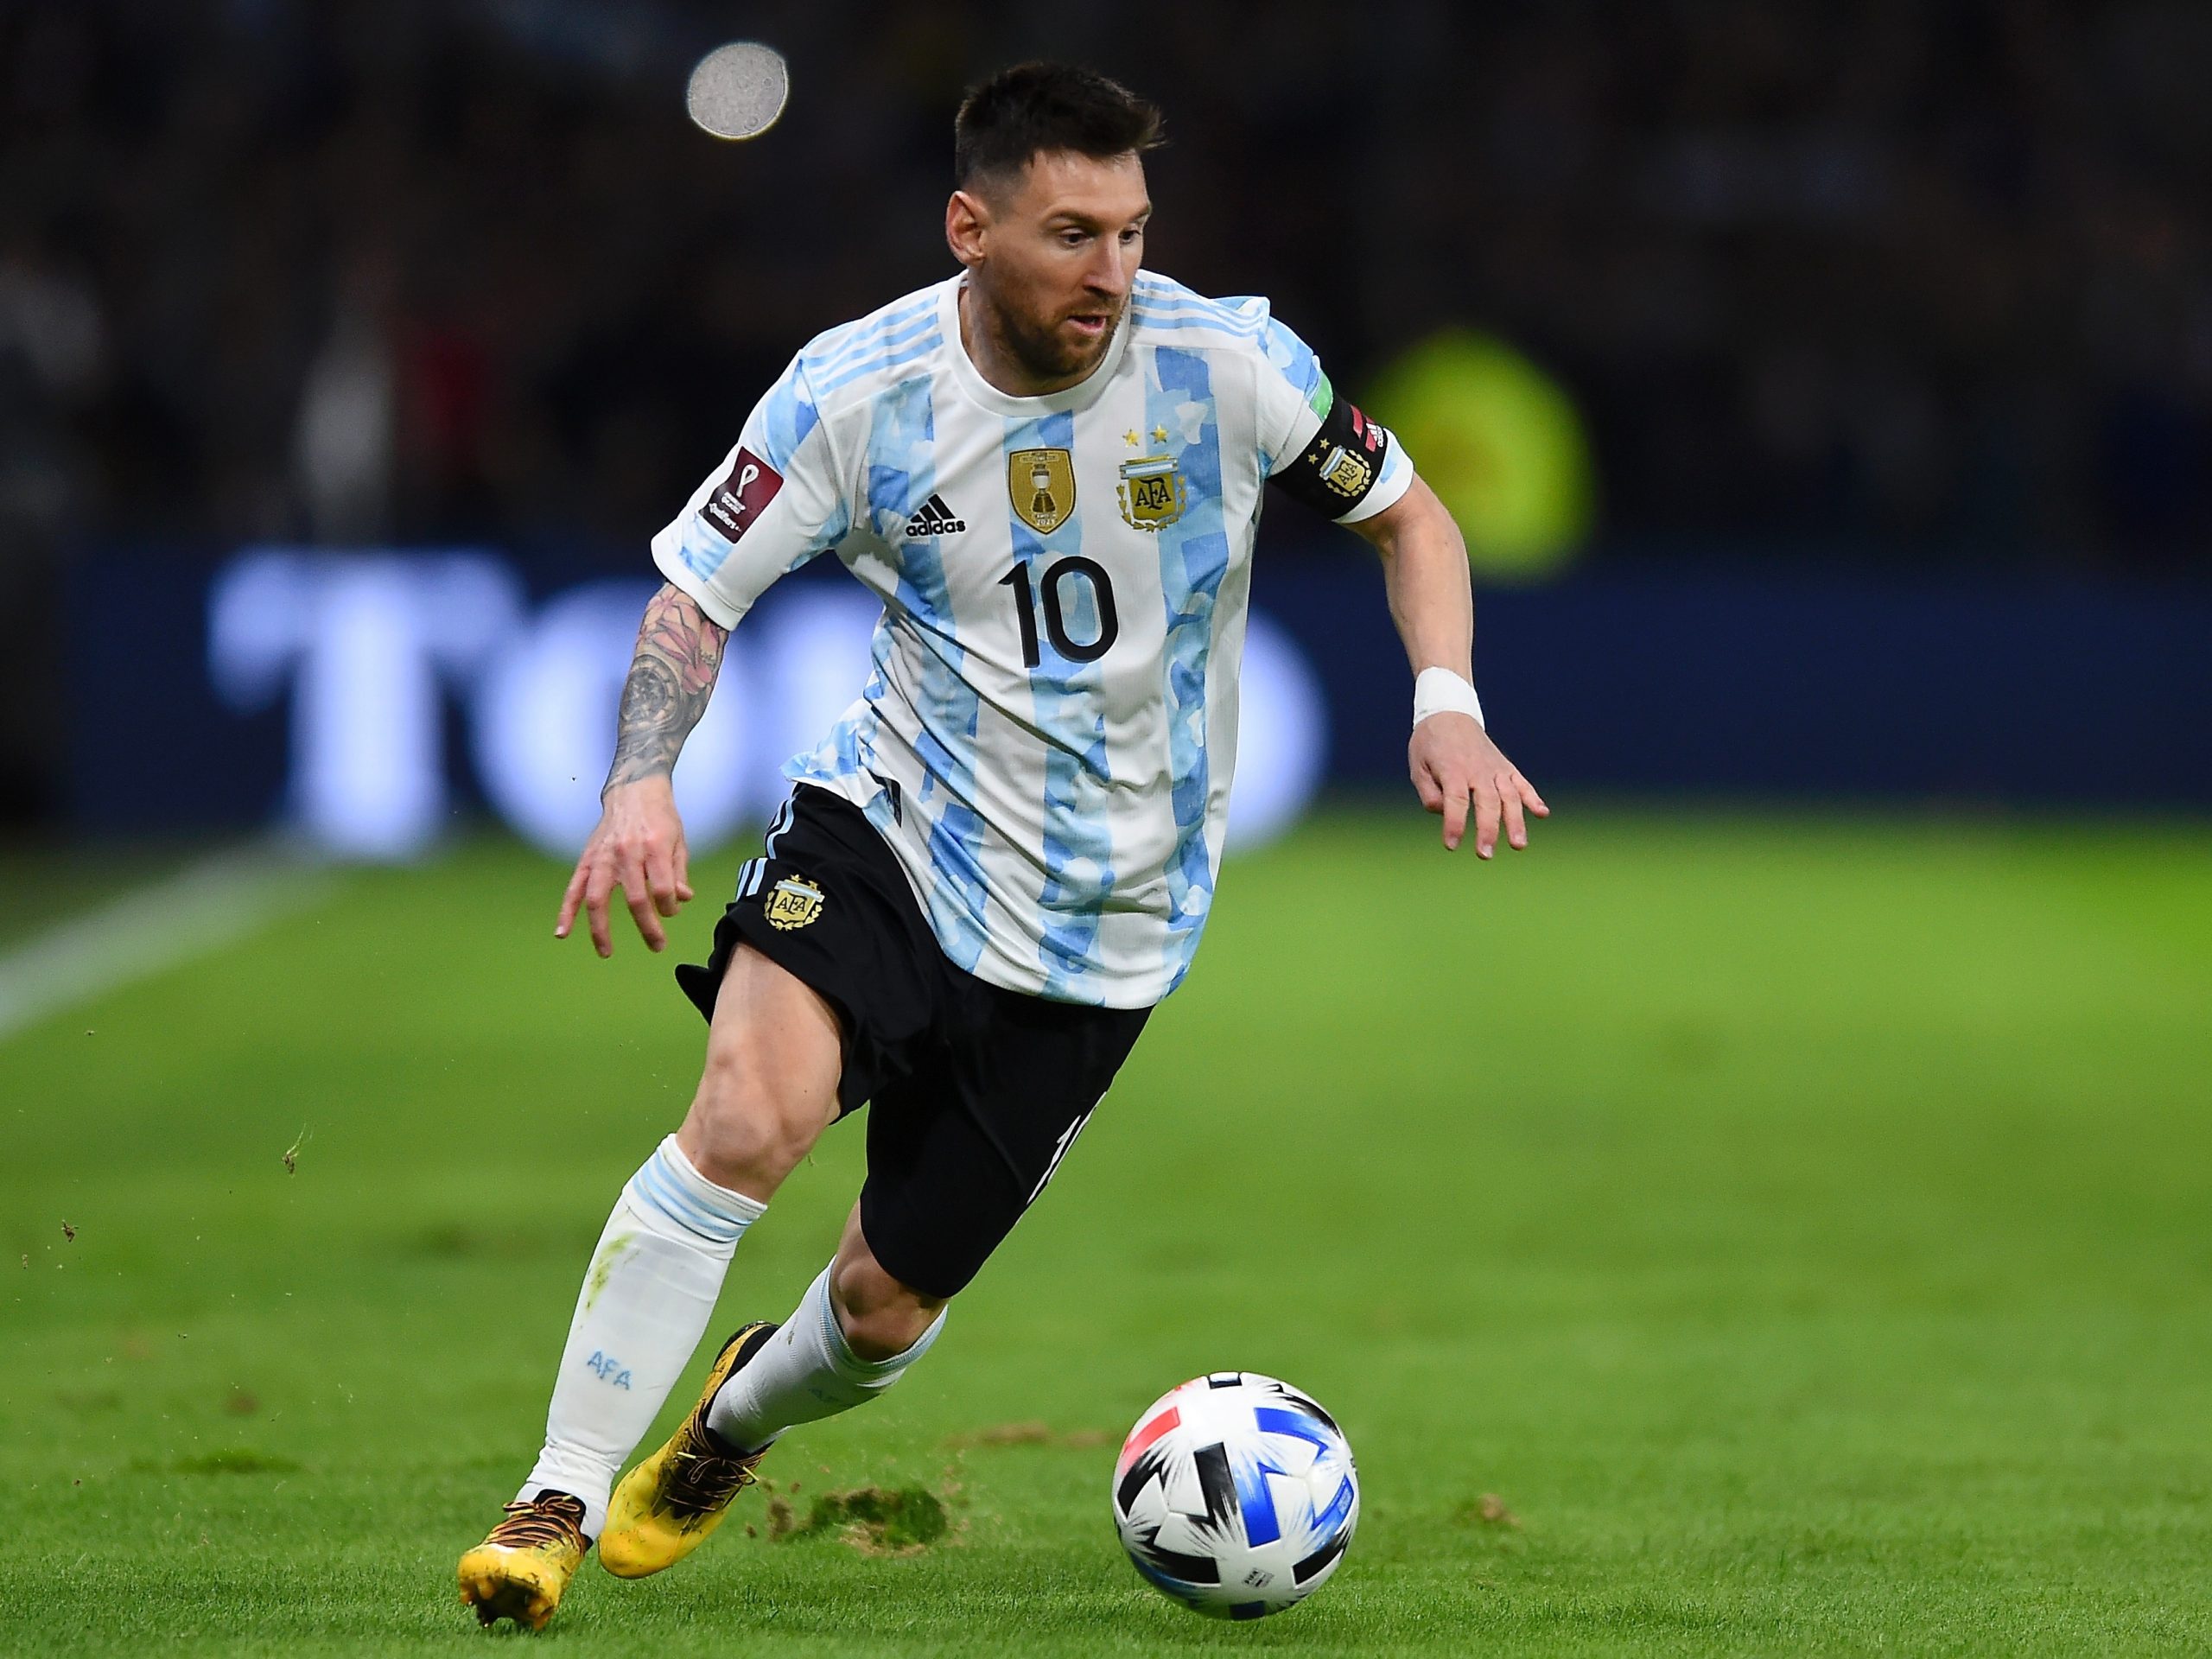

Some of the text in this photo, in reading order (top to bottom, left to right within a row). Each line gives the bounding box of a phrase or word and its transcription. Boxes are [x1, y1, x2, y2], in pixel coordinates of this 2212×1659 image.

[1135, 477, 1172, 510] AFA
[906, 520, 966, 537] adidas
[997, 556, 1118, 668] 10
[776, 892, 807, 915] AFA
[587, 1350, 632, 1390] AFA
